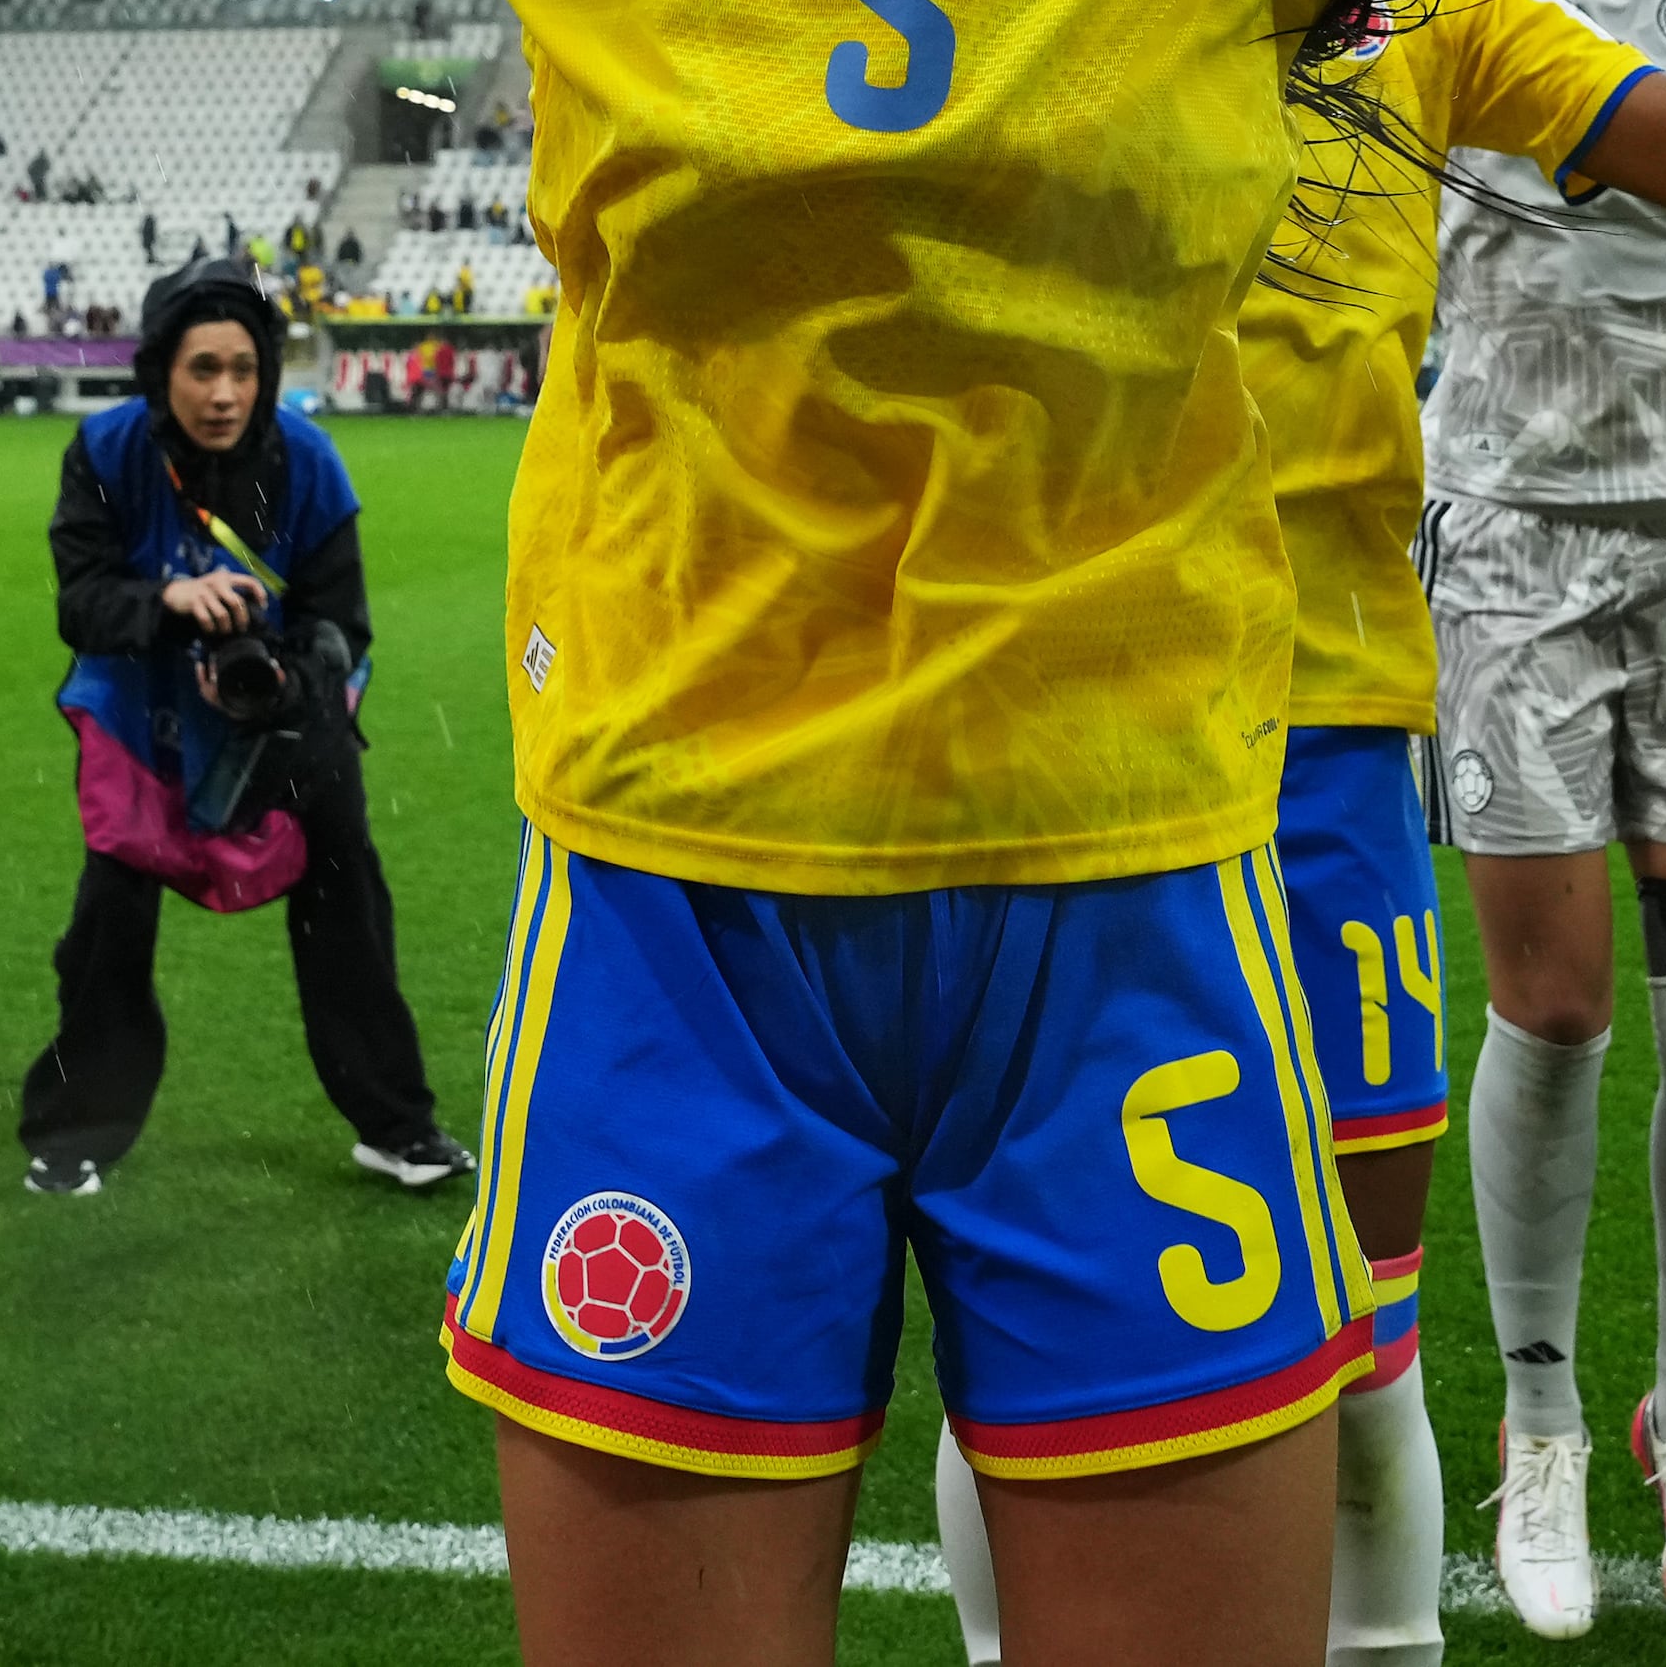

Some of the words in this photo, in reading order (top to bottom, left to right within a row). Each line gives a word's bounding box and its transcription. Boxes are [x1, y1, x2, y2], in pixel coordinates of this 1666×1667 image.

[1340, 908, 1444, 1086] 14
[592, 1197, 660, 1229] COLOMBIANA
[658, 1224, 673, 1241] DE
[1121, 1049, 1282, 1332] 5
